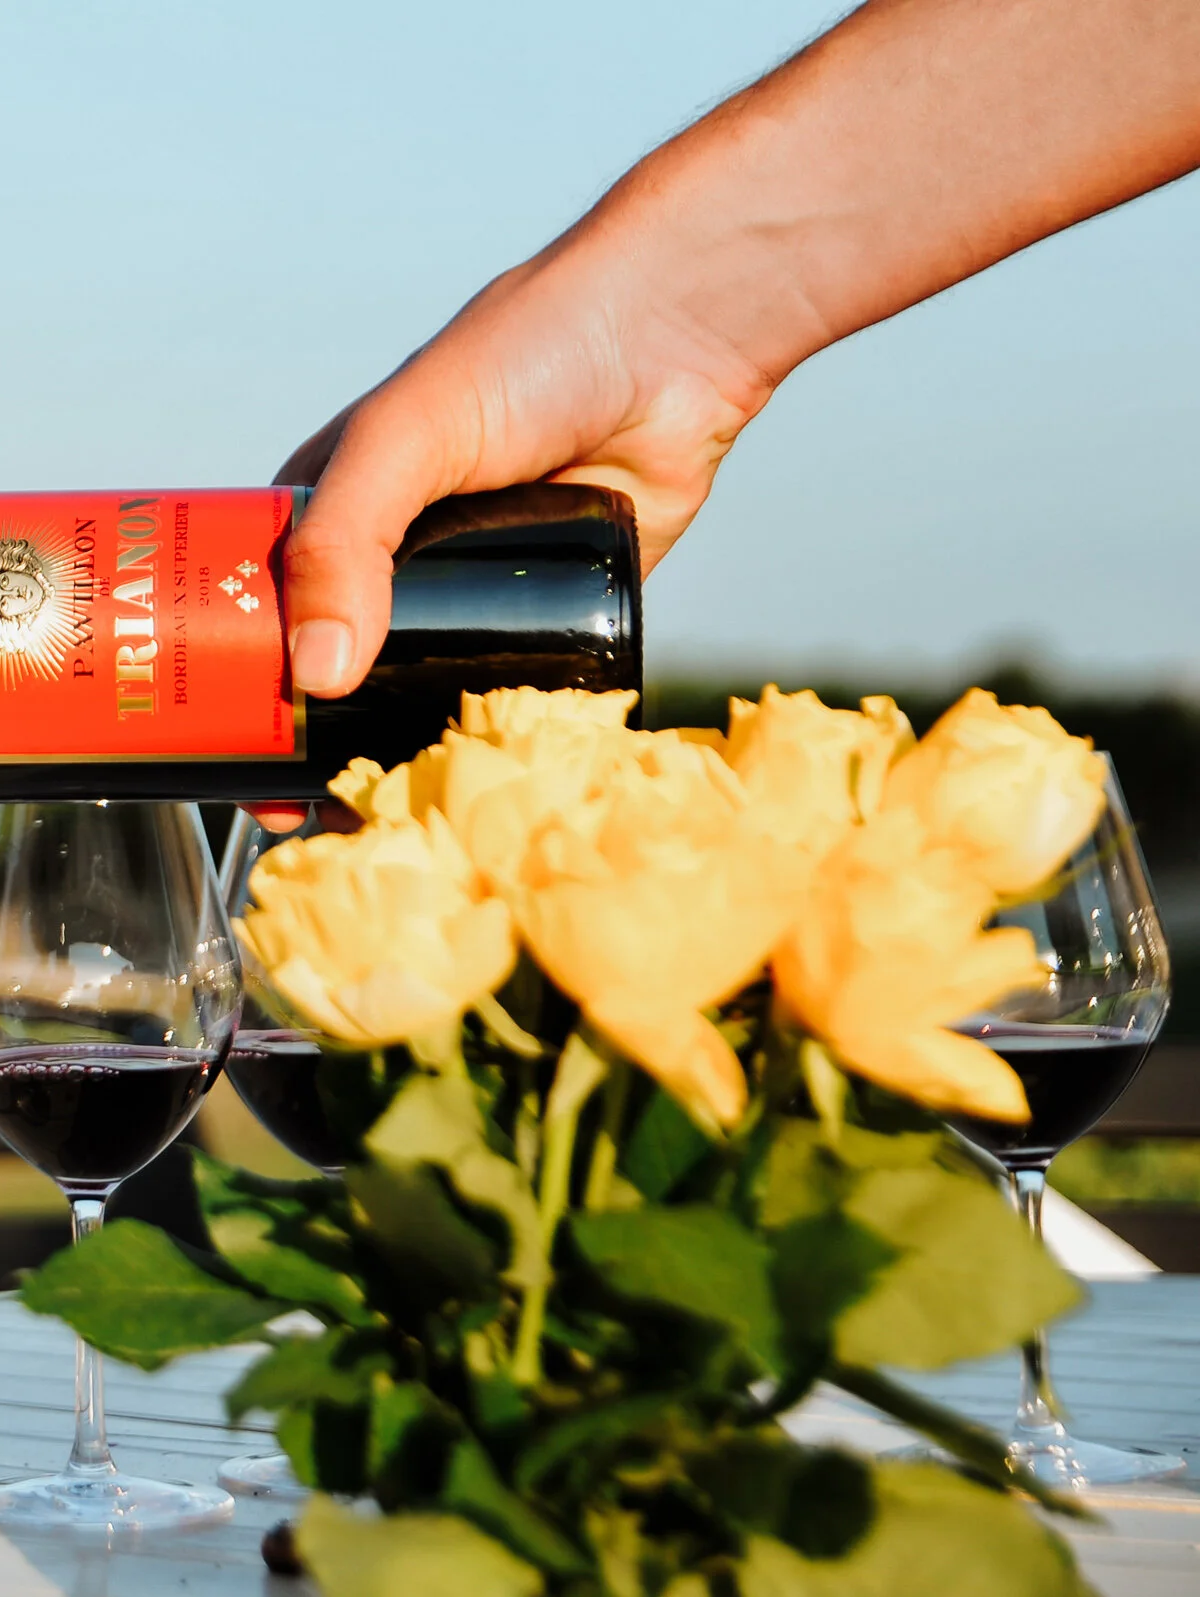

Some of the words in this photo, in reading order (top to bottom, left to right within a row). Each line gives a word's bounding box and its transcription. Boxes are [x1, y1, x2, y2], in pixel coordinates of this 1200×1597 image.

[101, 576, 110, 597] DE
[174, 501, 189, 589] SUPERIEUR
[199, 566, 209, 606] 2018
[73, 517, 96, 680] PAVILLON
[112, 495, 160, 721] TRIANON
[174, 593, 188, 705] BORDEAUX
